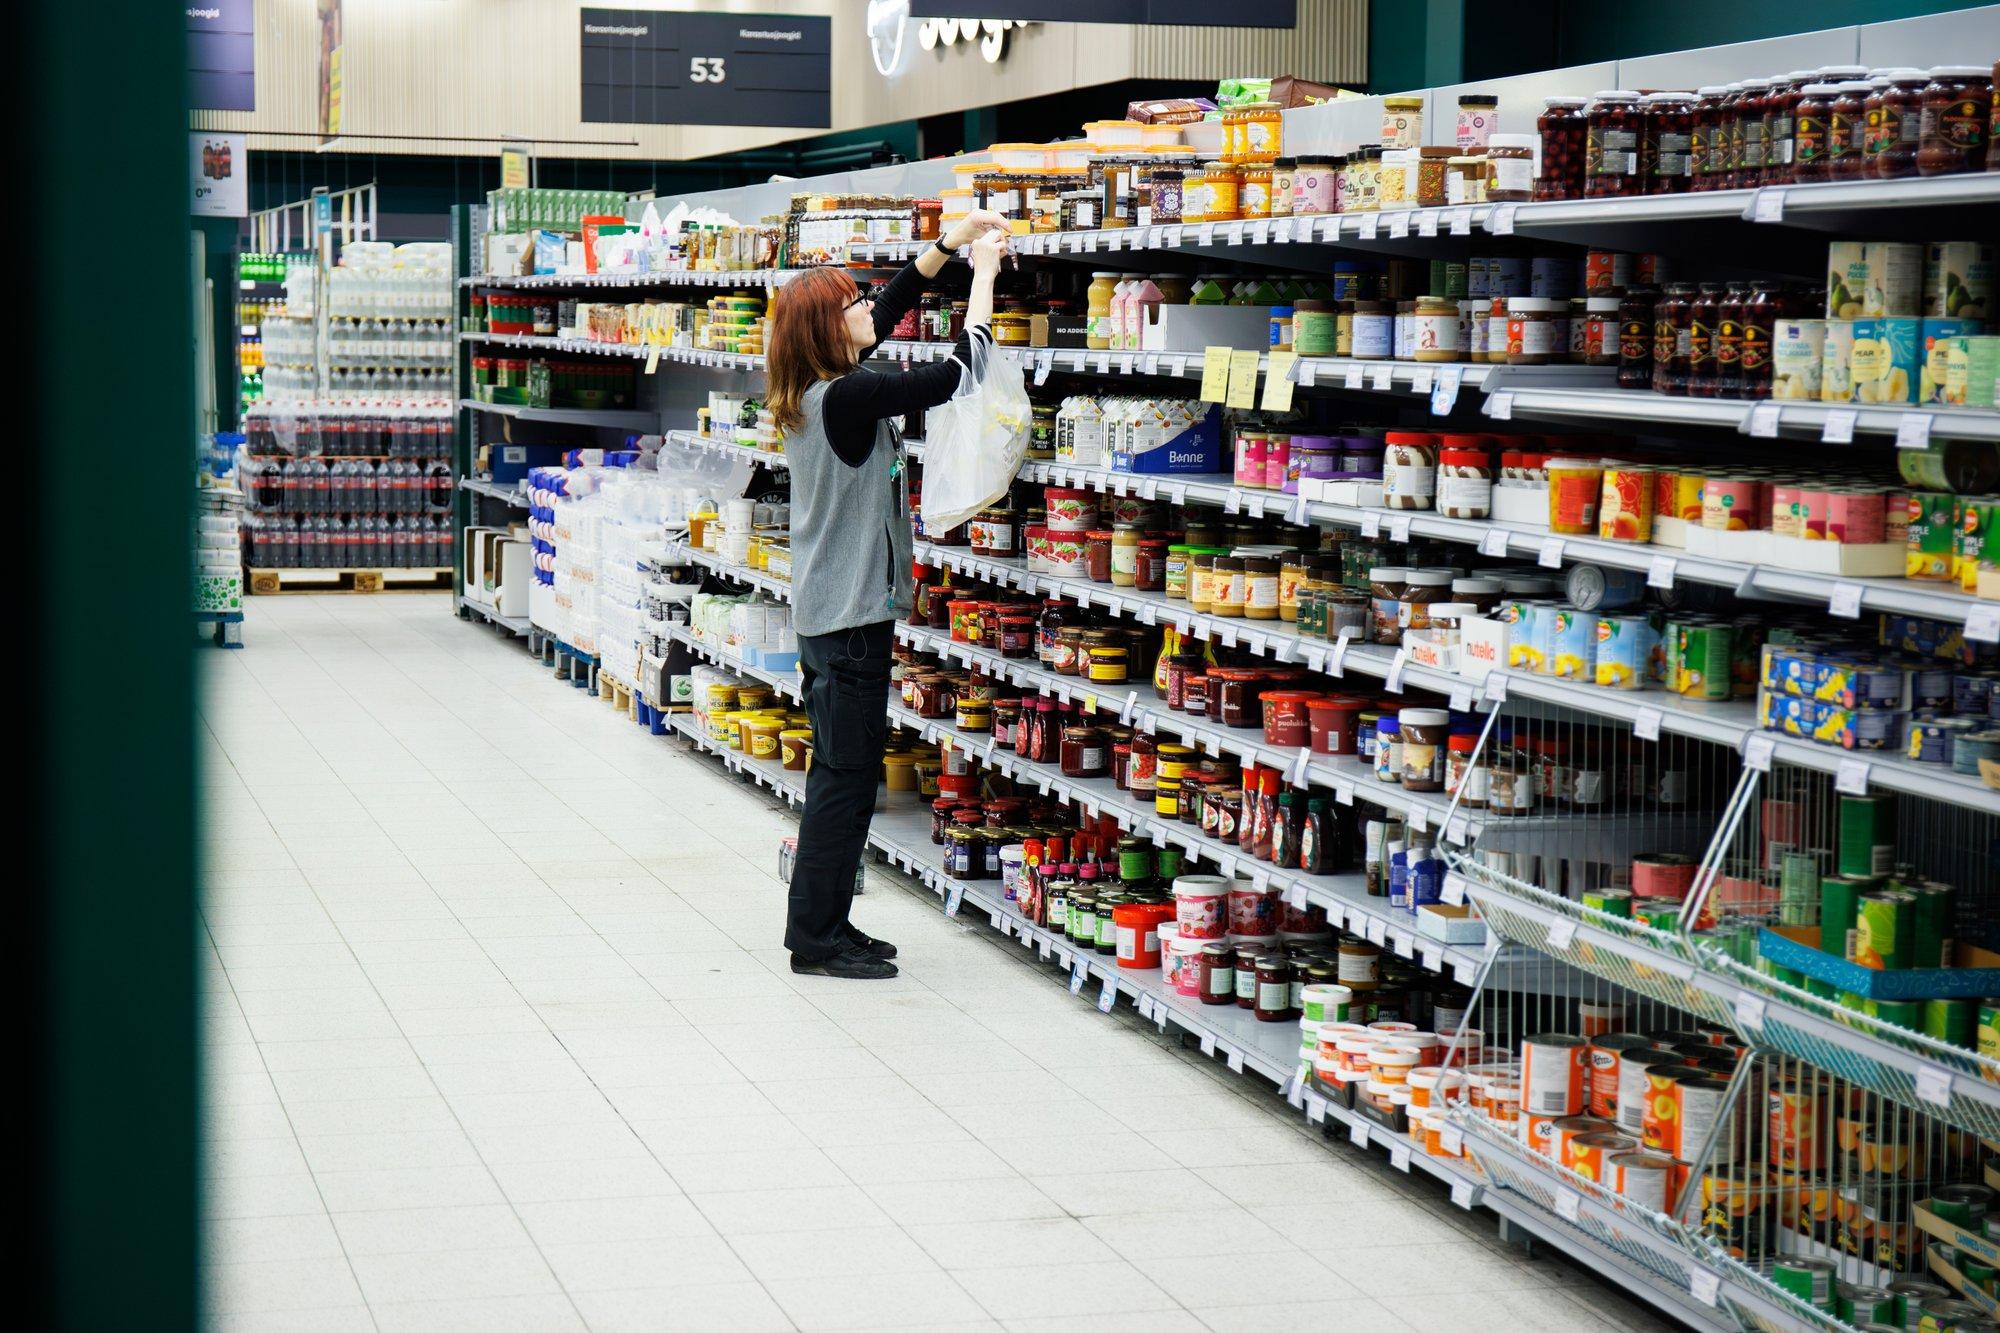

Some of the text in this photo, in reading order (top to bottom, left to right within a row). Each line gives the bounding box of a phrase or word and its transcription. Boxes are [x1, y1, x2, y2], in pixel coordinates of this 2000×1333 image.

[689, 57, 726, 83] 53
[1412, 645, 1438, 666] nutella
[1466, 641, 1495, 662] nutella
